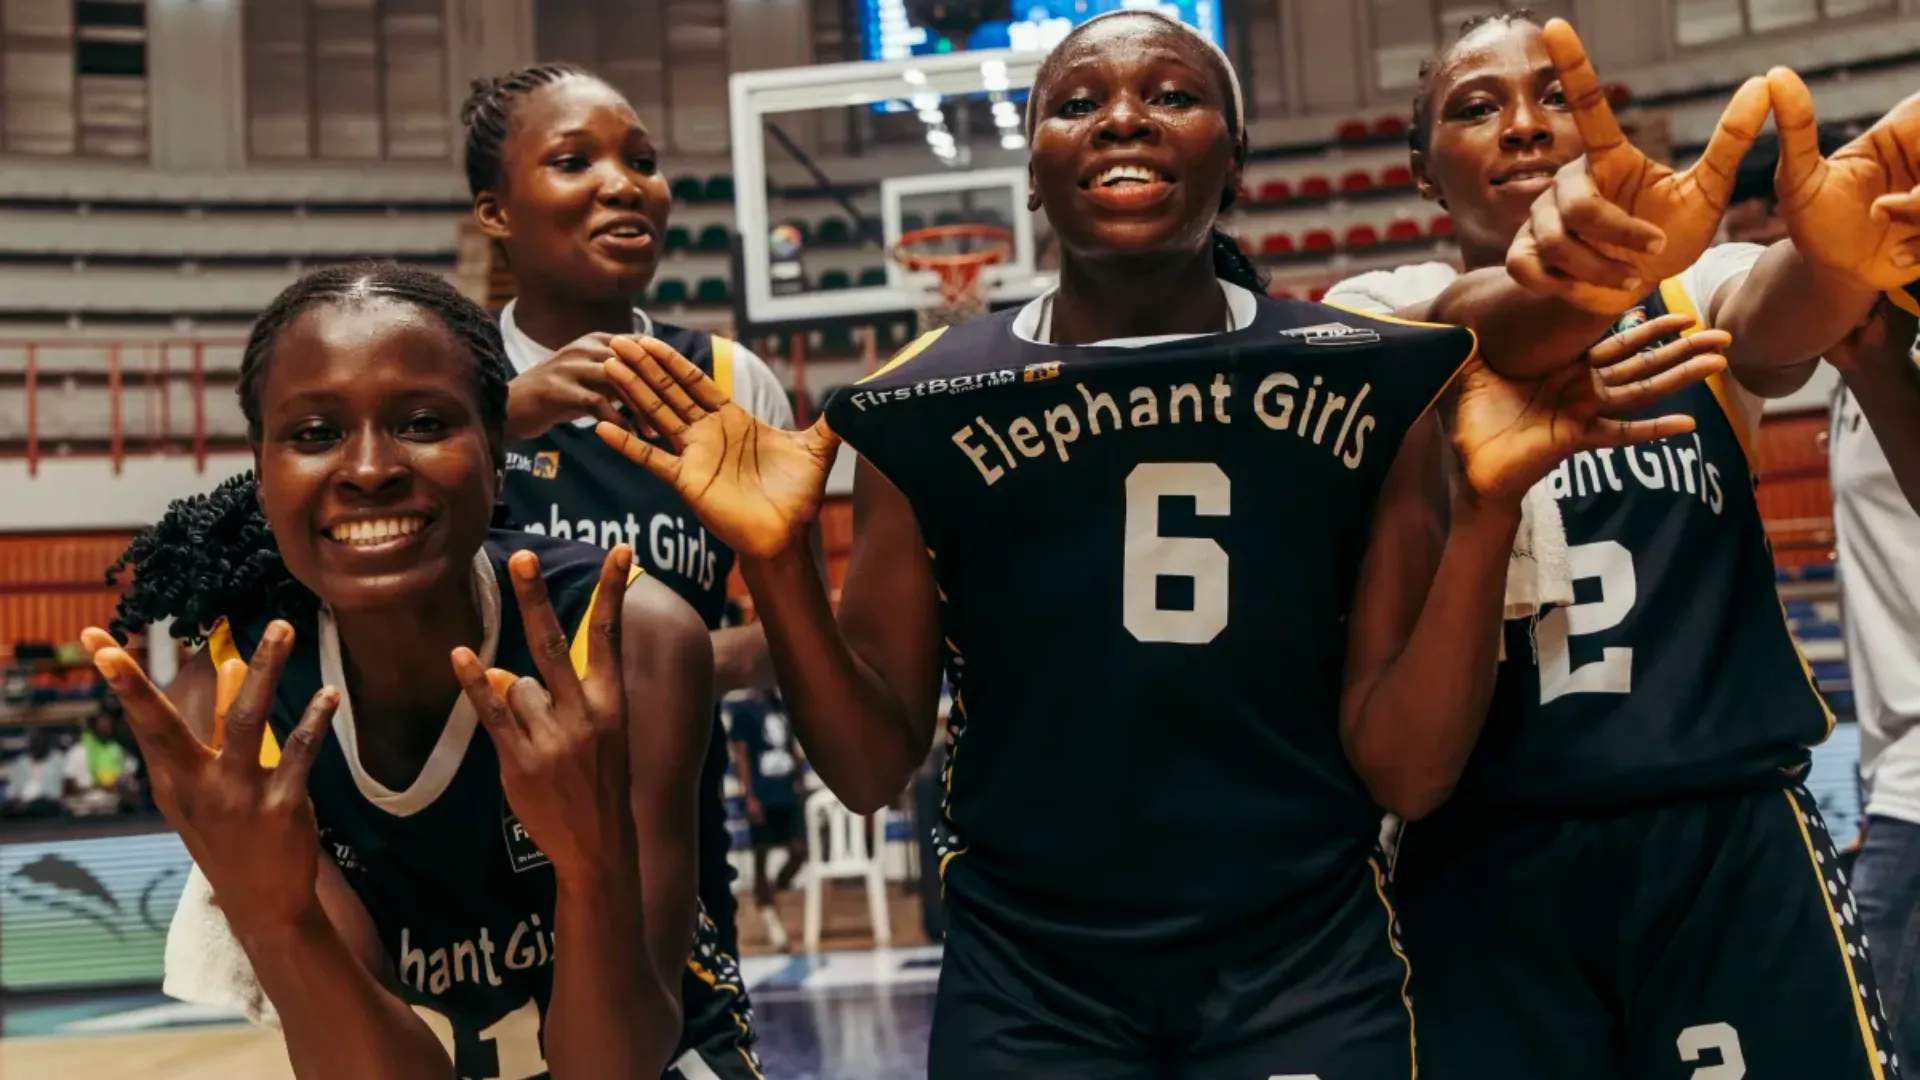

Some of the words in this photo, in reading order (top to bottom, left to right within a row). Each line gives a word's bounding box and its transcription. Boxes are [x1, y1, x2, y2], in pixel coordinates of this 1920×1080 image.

[952, 373, 1232, 486] Elephant
[1254, 371, 1376, 470] Girls
[1624, 432, 1723, 516] Girls
[523, 502, 641, 566] hant
[649, 512, 717, 592] Girls
[1123, 462, 1231, 644] 6
[1536, 539, 1637, 706] 2
